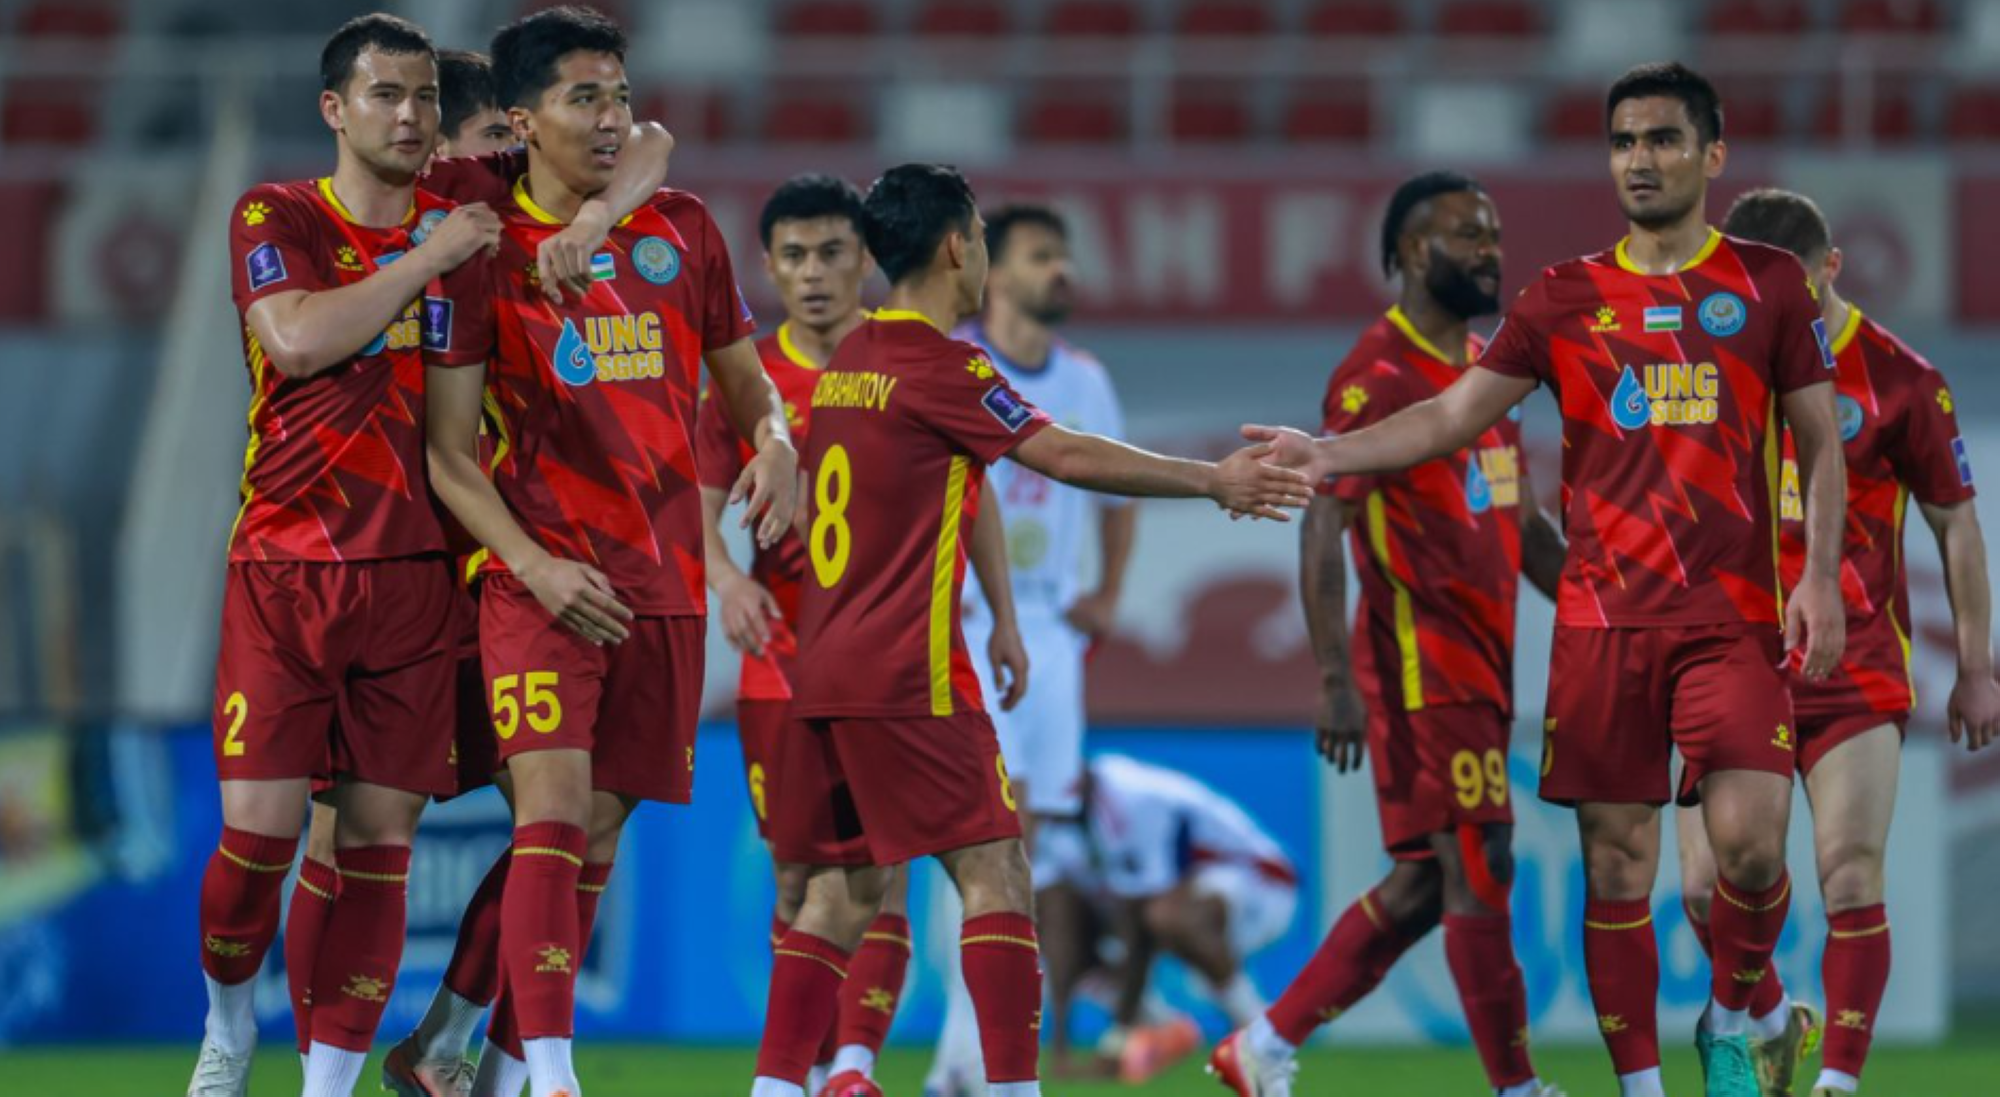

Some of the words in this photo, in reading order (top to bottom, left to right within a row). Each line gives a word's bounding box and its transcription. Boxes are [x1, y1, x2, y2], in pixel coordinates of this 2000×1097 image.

[585, 311, 663, 354] UNG
[594, 350, 665, 382] SGCC
[1643, 362, 1719, 399] UNG
[1649, 397, 1719, 426] SGCC
[809, 444, 851, 589] 8
[223, 691, 248, 756] 2
[493, 671, 563, 740] 55
[1451, 748, 1507, 809] 99
